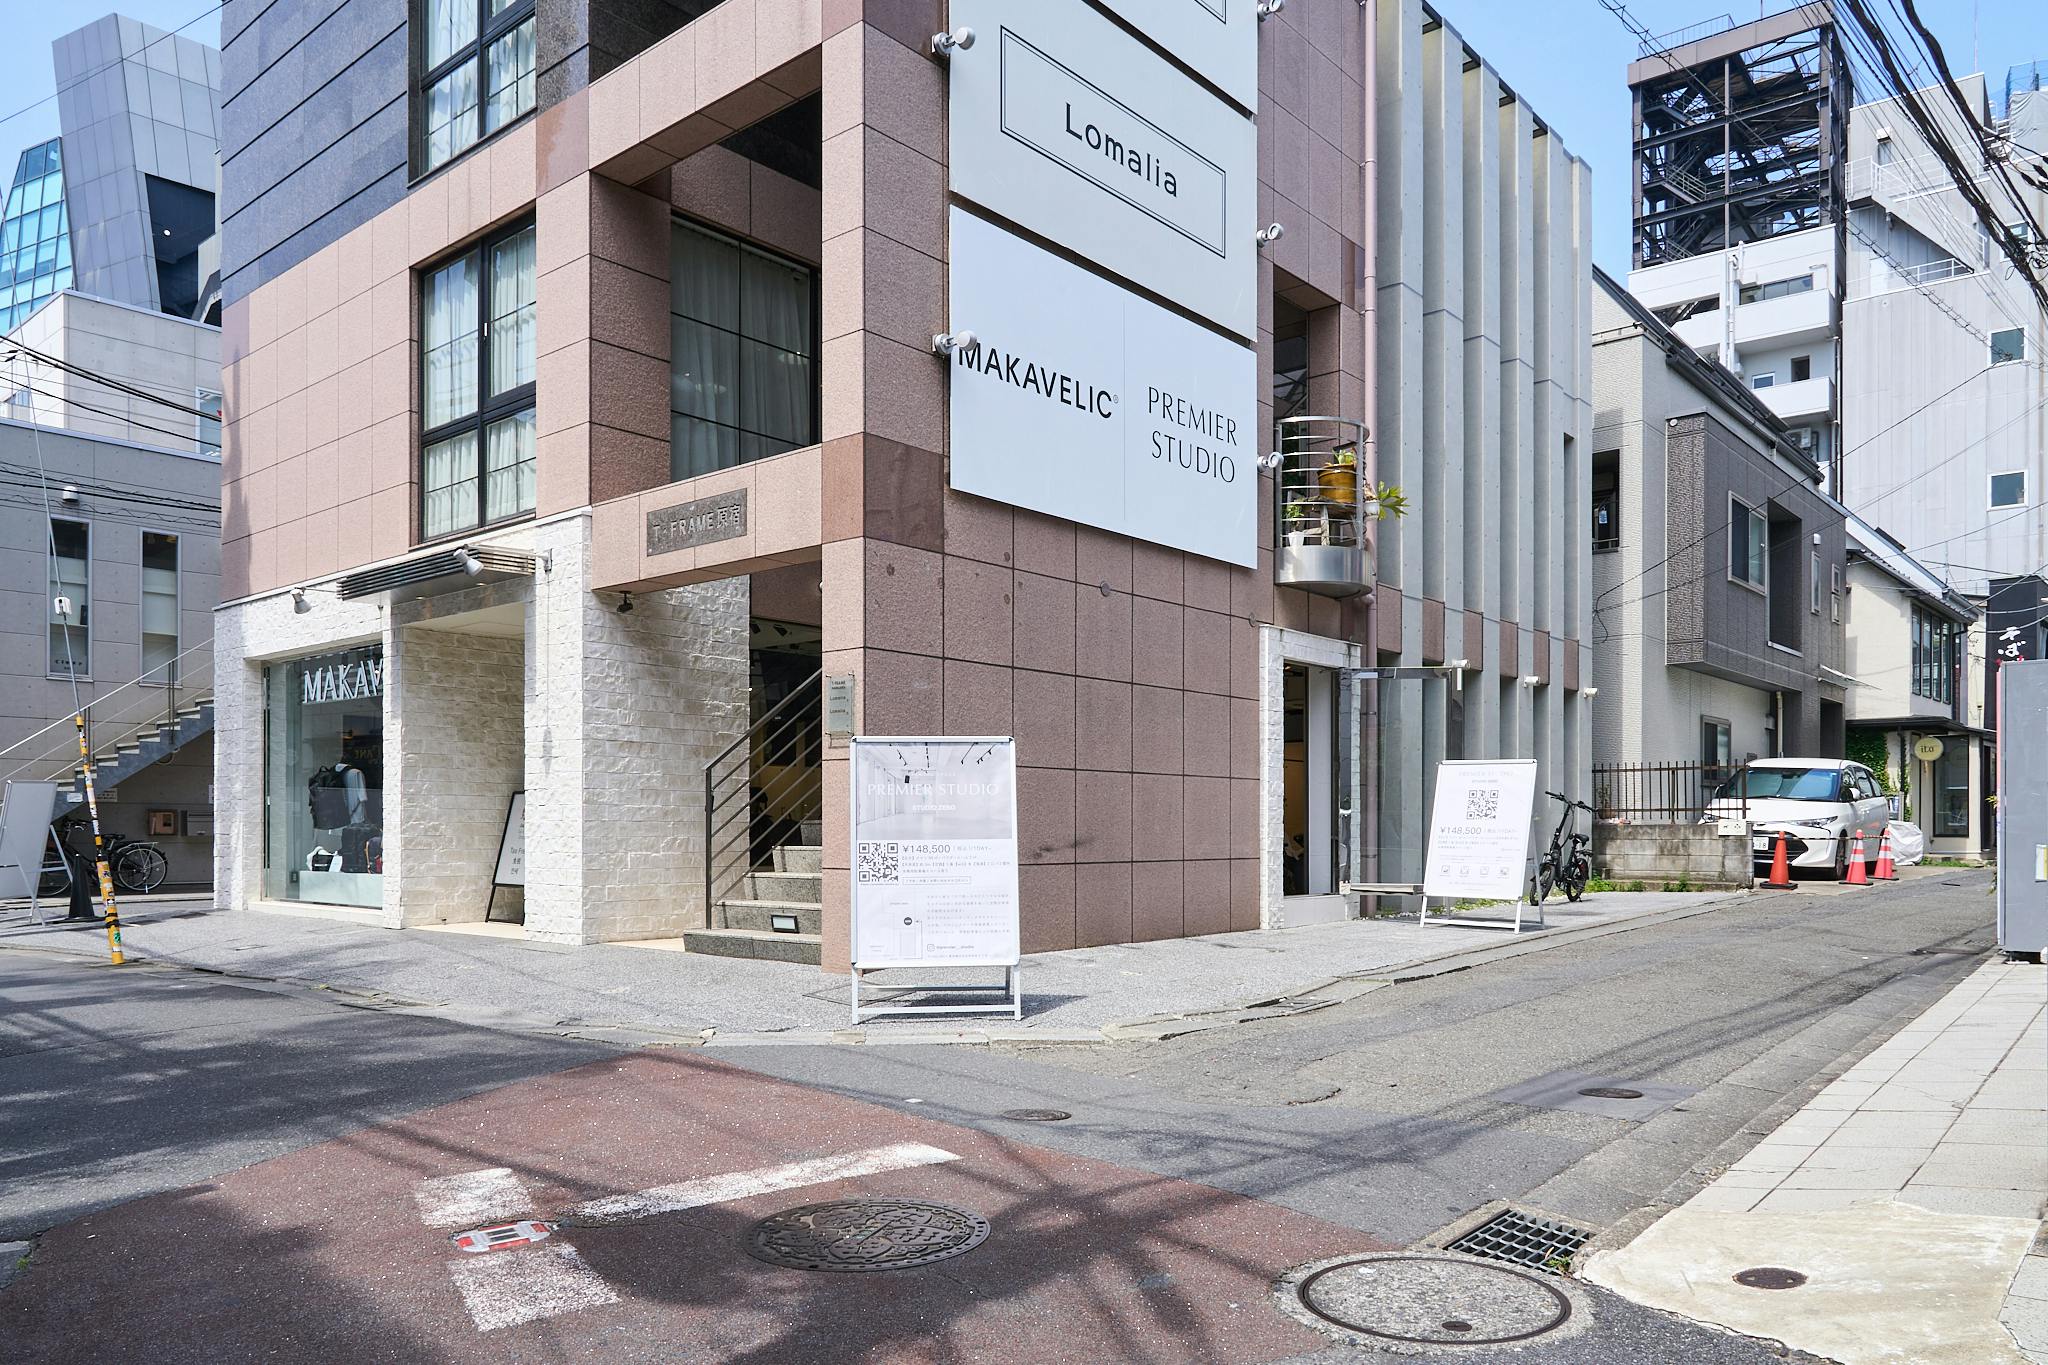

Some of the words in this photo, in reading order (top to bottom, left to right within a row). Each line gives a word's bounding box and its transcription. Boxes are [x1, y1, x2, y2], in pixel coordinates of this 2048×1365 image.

[1065, 102, 1177, 198] Lomalia
[1148, 386, 1237, 447] PREMIER
[1151, 430, 1235, 483] STUDIO
[1997, 626, 2027, 660] そば
[867, 783, 933, 796] PREMIER
[938, 783, 1000, 796] STUDIO
[1440, 826, 1482, 835] ¥148,500
[902, 844, 951, 854] ¥148,500
